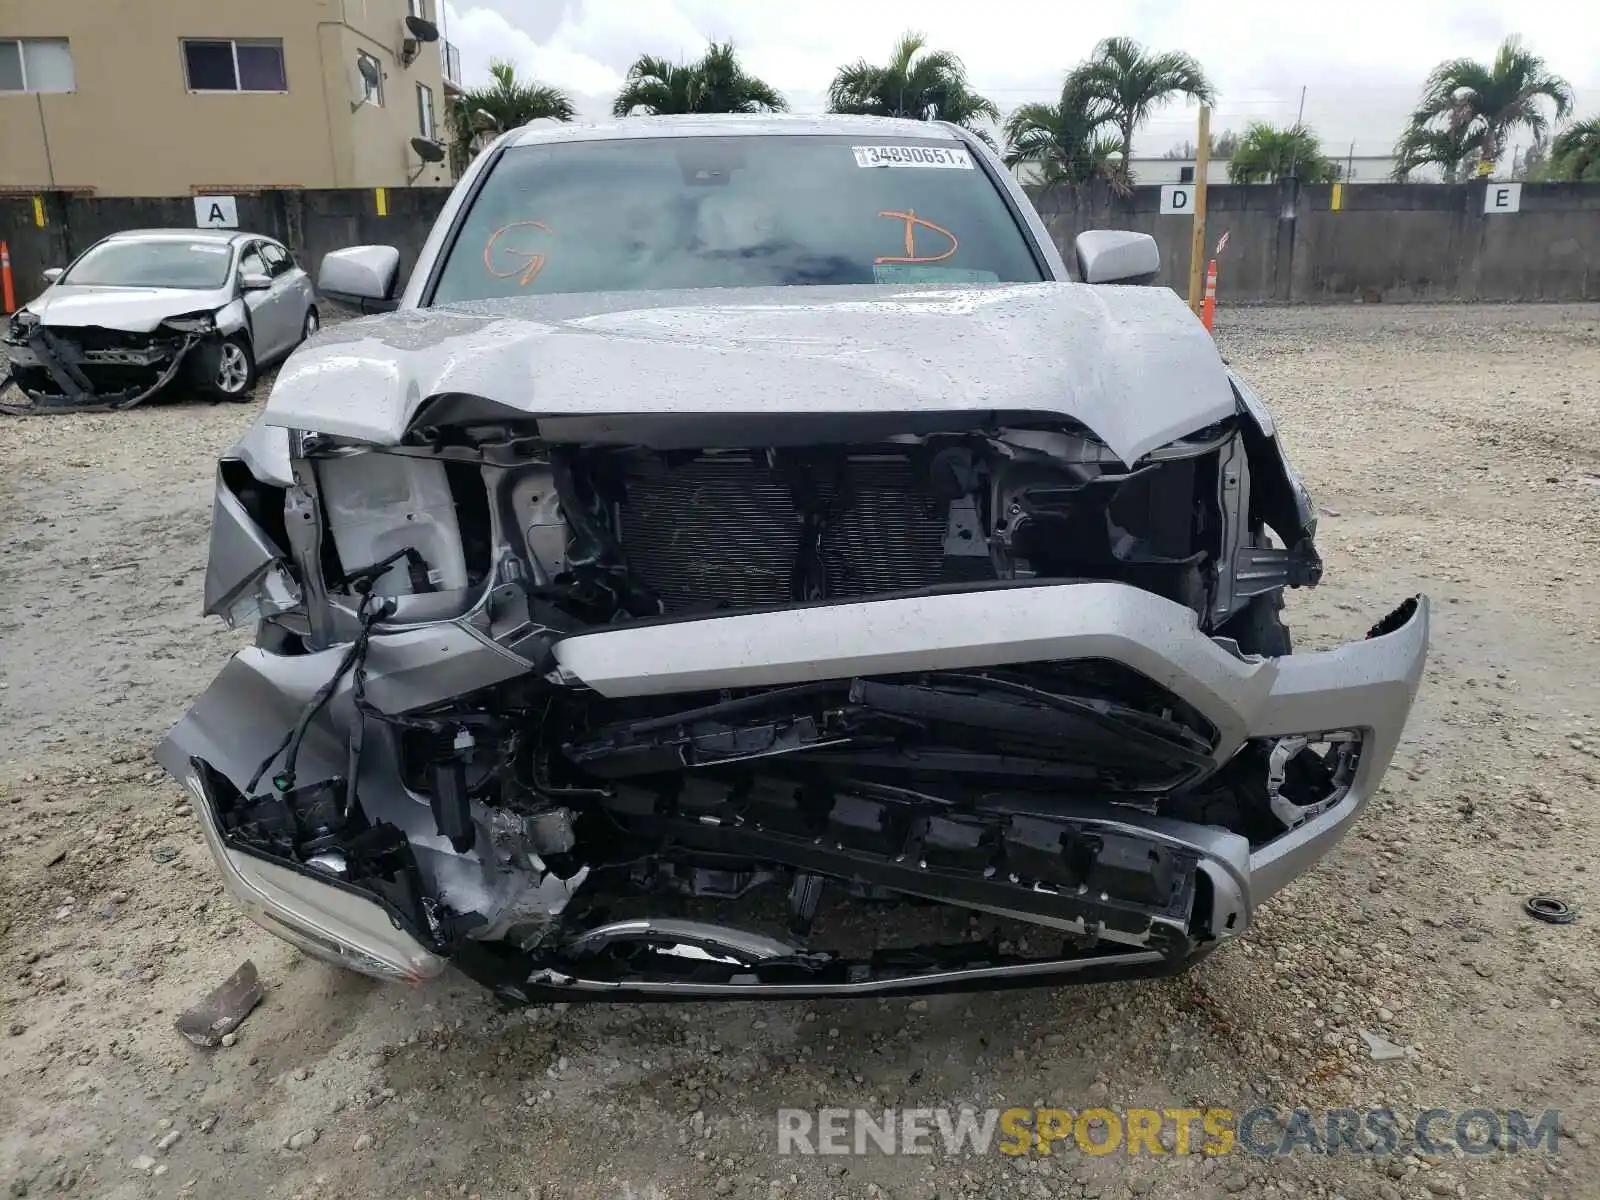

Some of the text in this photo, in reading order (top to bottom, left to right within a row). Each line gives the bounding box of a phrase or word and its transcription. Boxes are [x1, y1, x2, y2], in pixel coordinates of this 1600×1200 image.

[868, 147, 955, 164] 34890651
[1172, 190, 1187, 209] D
[1495, 189, 1509, 207] E
[208, 203, 225, 222] A
[876, 208, 959, 264] D
